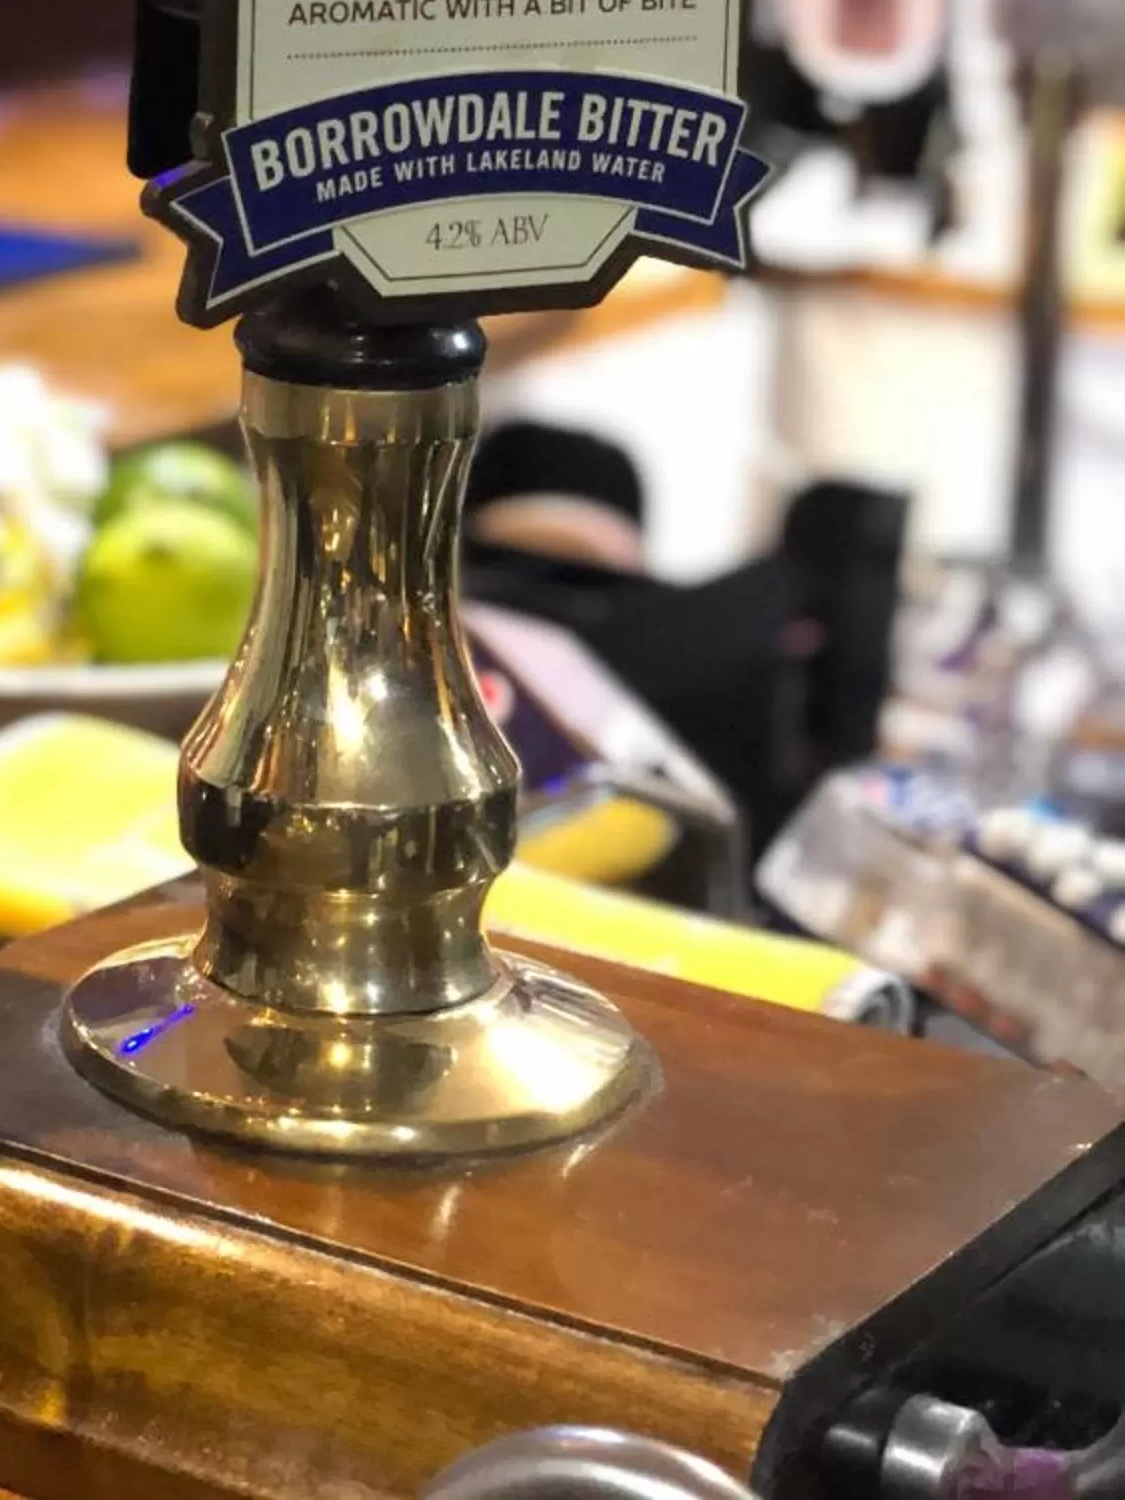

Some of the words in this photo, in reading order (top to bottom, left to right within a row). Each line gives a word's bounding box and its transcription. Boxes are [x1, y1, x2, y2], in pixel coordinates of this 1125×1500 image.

[250, 91, 562, 192] BORROWDALE
[578, 93, 729, 167] BITTER
[316, 168, 383, 202] MADE
[394, 154, 455, 183] WITH
[466, 149, 581, 173] LAKELAND
[592, 153, 666, 184] WATER
[490, 211, 549, 246] ABV
